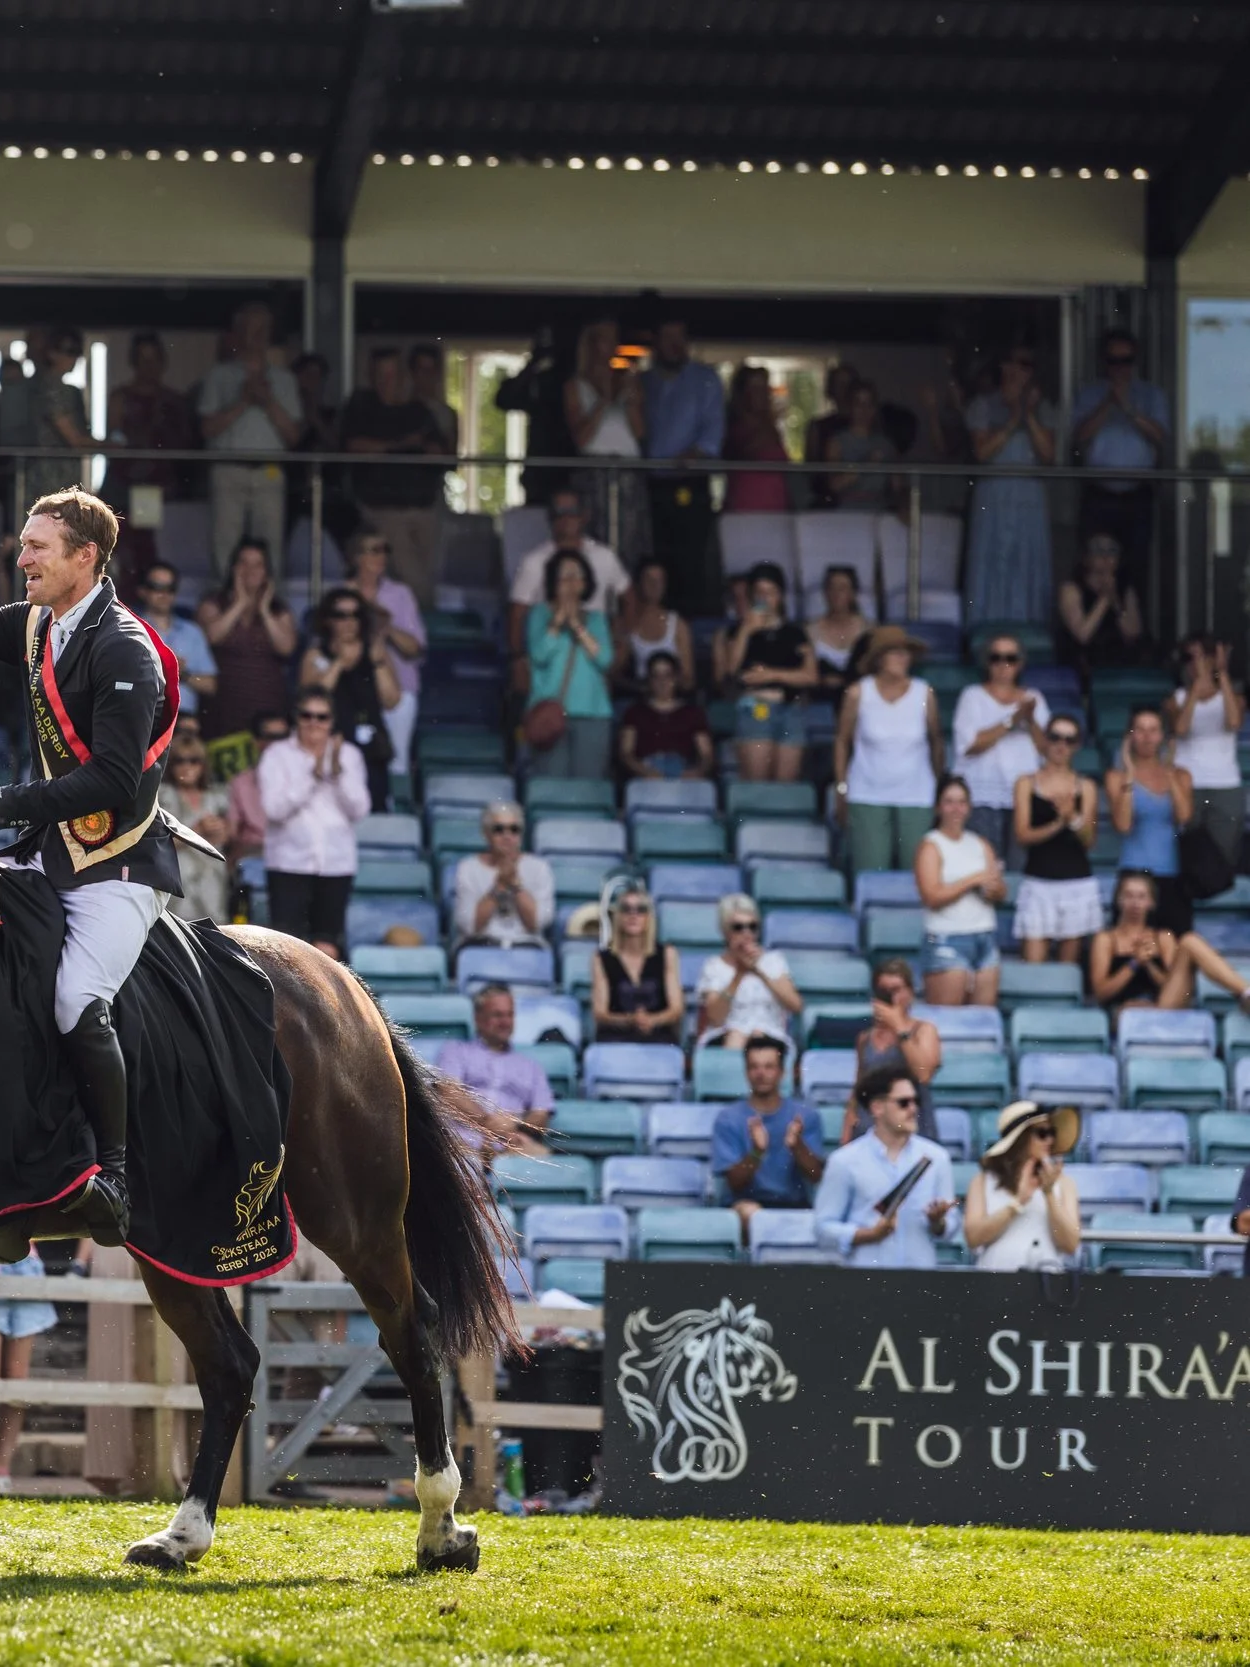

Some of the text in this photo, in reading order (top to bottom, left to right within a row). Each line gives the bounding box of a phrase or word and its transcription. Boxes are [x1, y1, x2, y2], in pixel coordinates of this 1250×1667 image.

[43, 717, 70, 759] DERBY
[236, 1215, 282, 1242] HIRA'AA
[216, 1245, 278, 1273] DERBY 2026
[853, 1326, 955, 1394] AL
[853, 1416, 1098, 1473] TOUR
